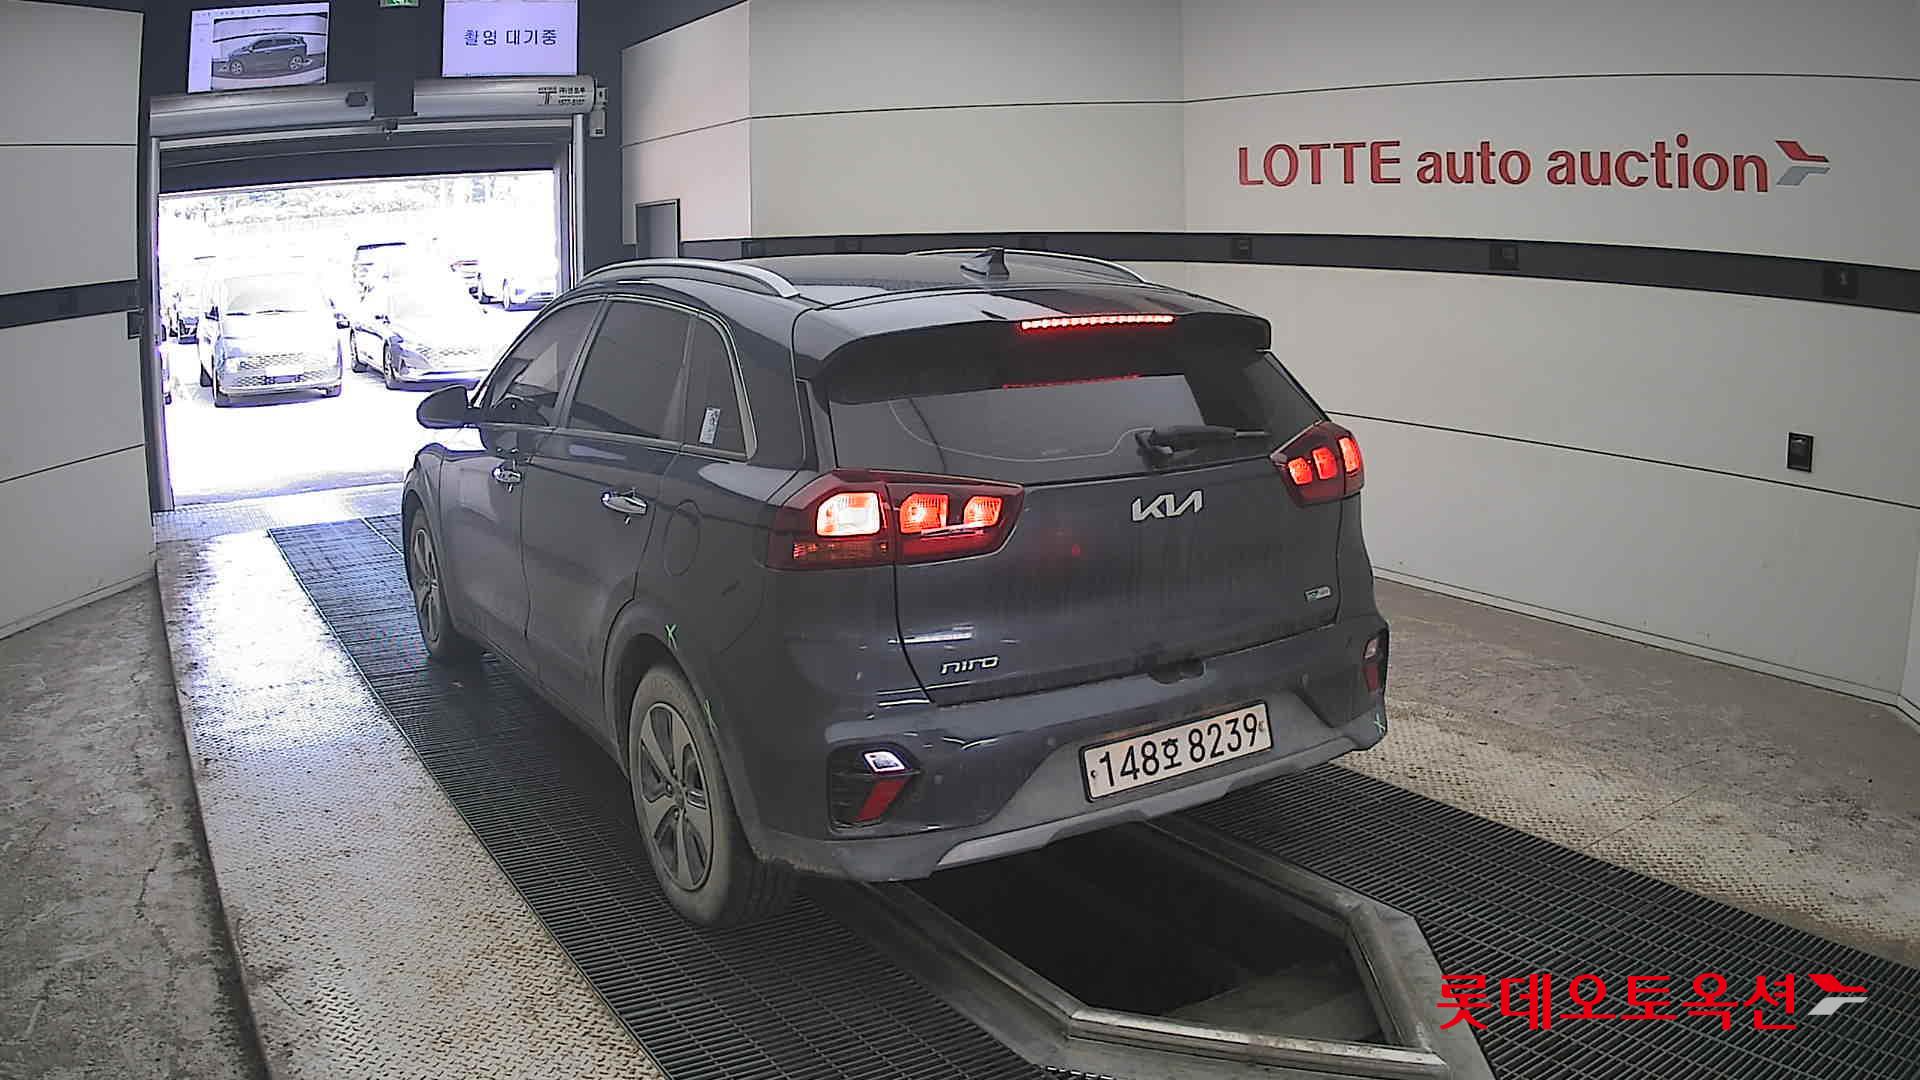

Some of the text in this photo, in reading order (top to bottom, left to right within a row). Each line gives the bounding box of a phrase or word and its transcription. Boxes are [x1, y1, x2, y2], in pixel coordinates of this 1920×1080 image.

[505, 29, 557, 46] 대기중
[1238, 133, 1768, 192] LOTTE auto auction
